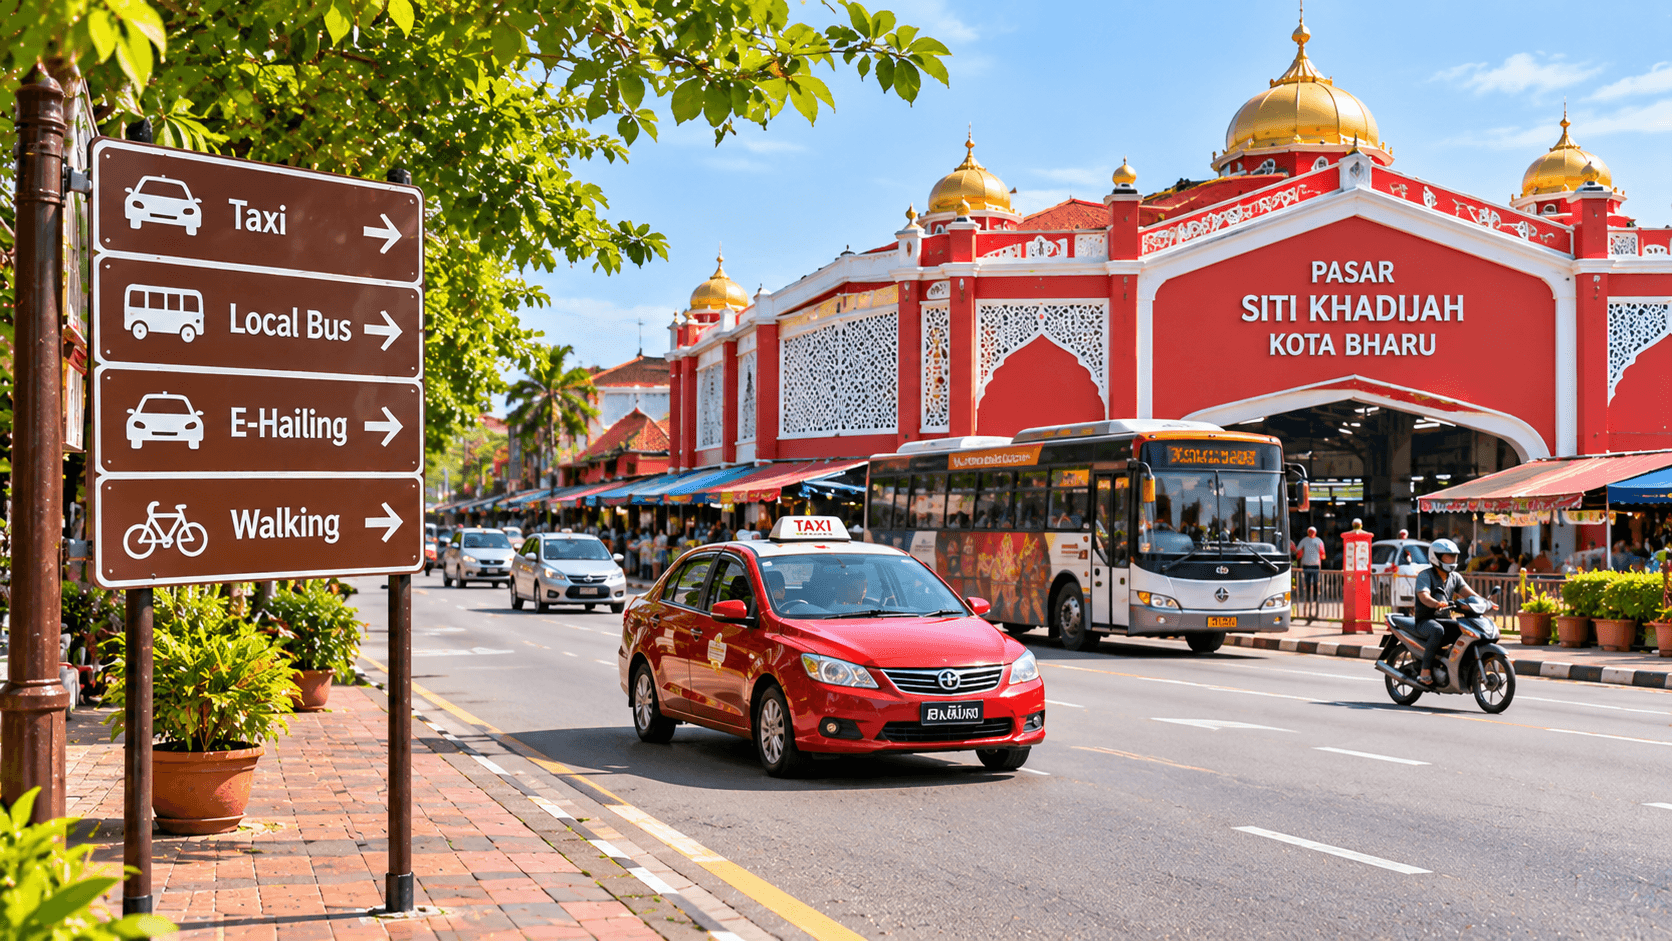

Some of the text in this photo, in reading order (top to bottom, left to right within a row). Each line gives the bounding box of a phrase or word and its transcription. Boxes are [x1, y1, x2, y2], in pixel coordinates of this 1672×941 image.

[228, 198, 287, 236] Taxi
[1311, 260, 1395, 283] PASAR
[230, 302, 352, 342] Local Bus
[1241, 294, 1464, 322] SITI KHADIJAH
[1269, 332, 1436, 356] KOTA BHARU
[230, 406, 348, 447] E-Hailing
[229, 506, 340, 544] Walking
[793, 519, 832, 532] TAXI
